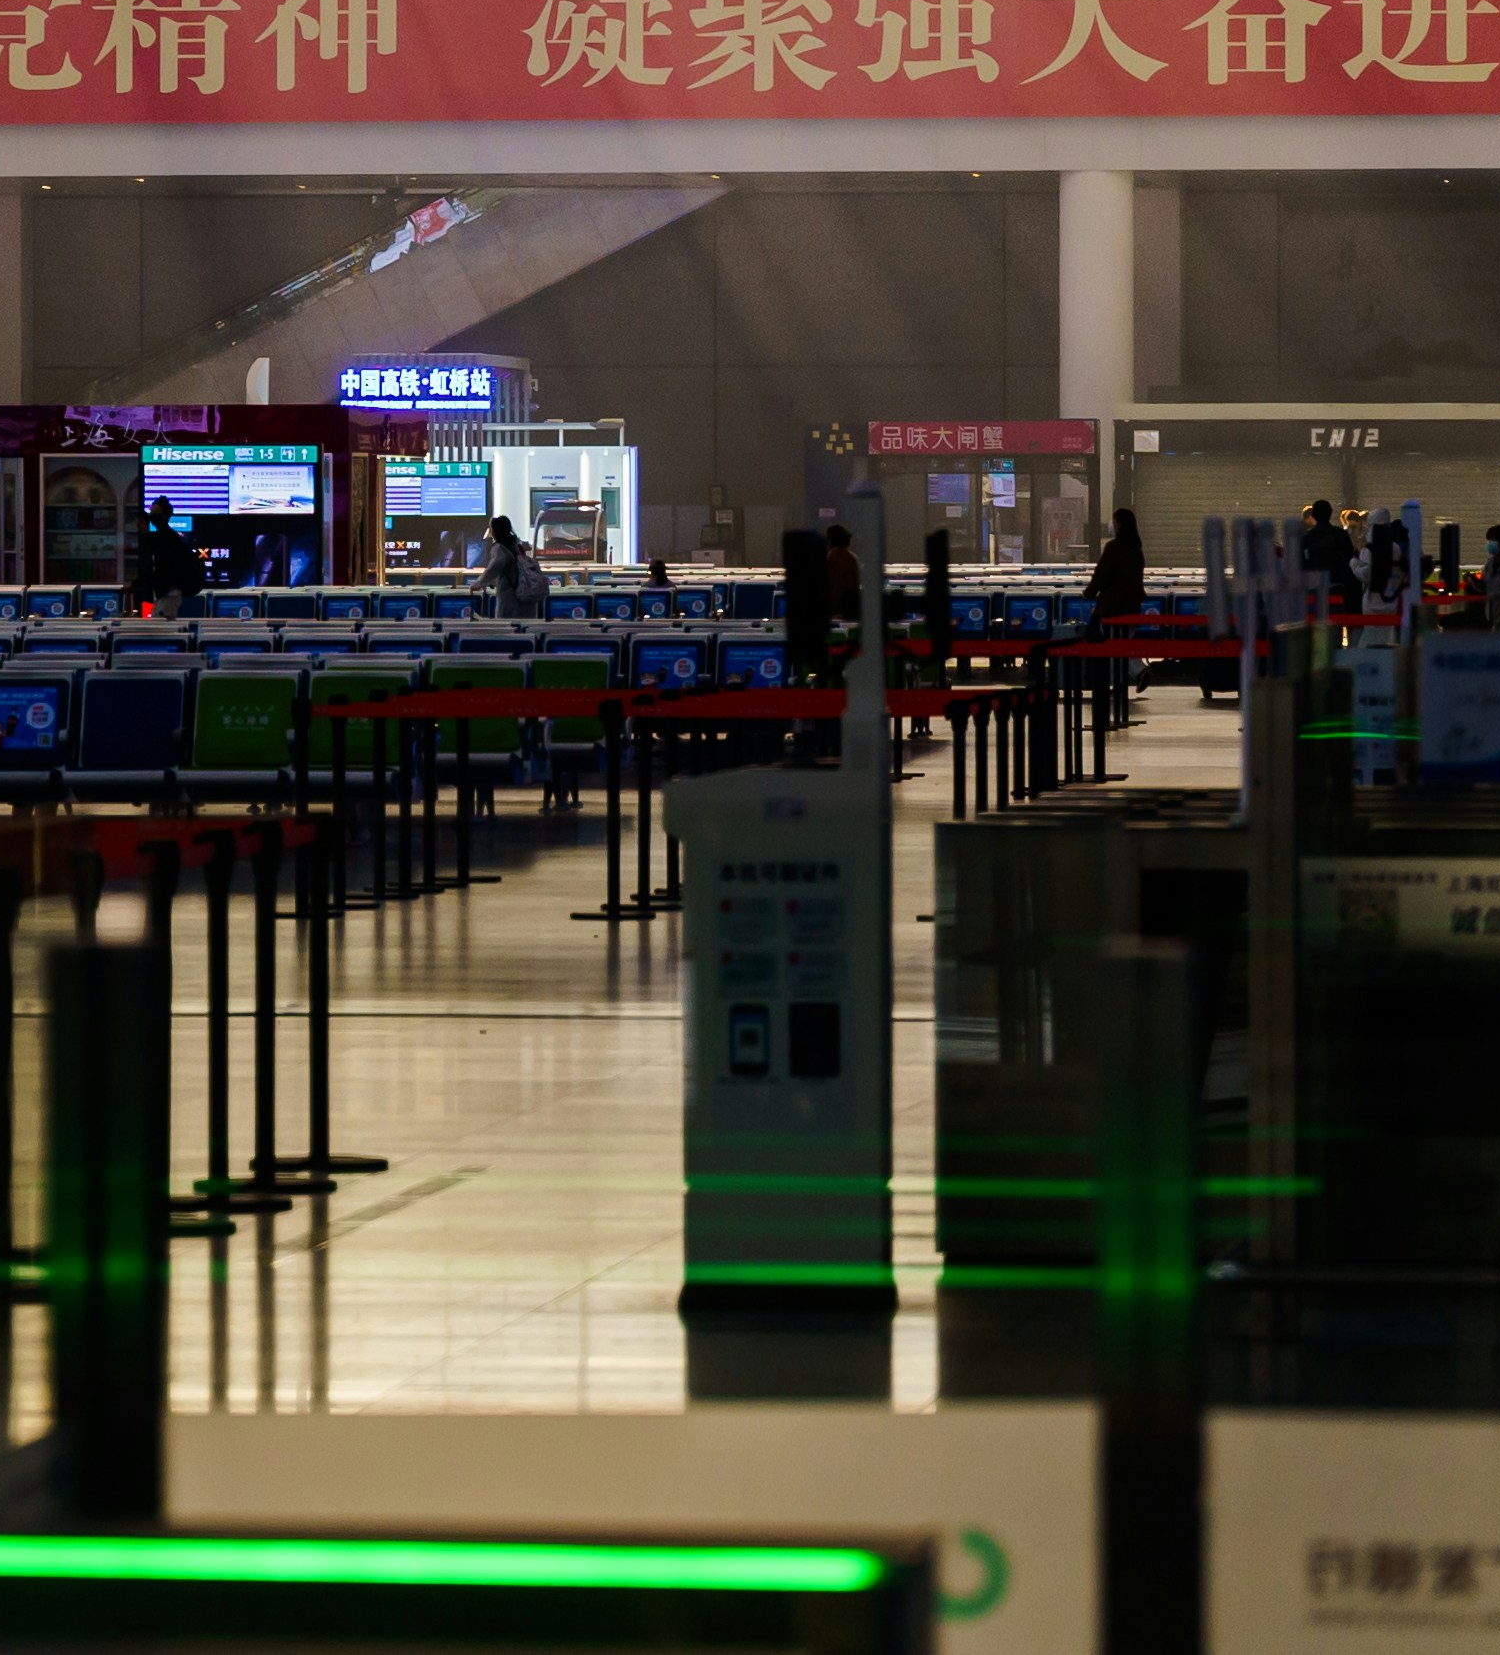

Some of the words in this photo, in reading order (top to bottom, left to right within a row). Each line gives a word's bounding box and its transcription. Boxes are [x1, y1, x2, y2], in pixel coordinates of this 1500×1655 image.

[340, 368, 491, 398] 中国高铁·虹桥站
[881, 425, 1005, 451] 品味大闸蟹
[152, 447, 225, 461] Hisense
[258, 448, 274, 460] 1-5
